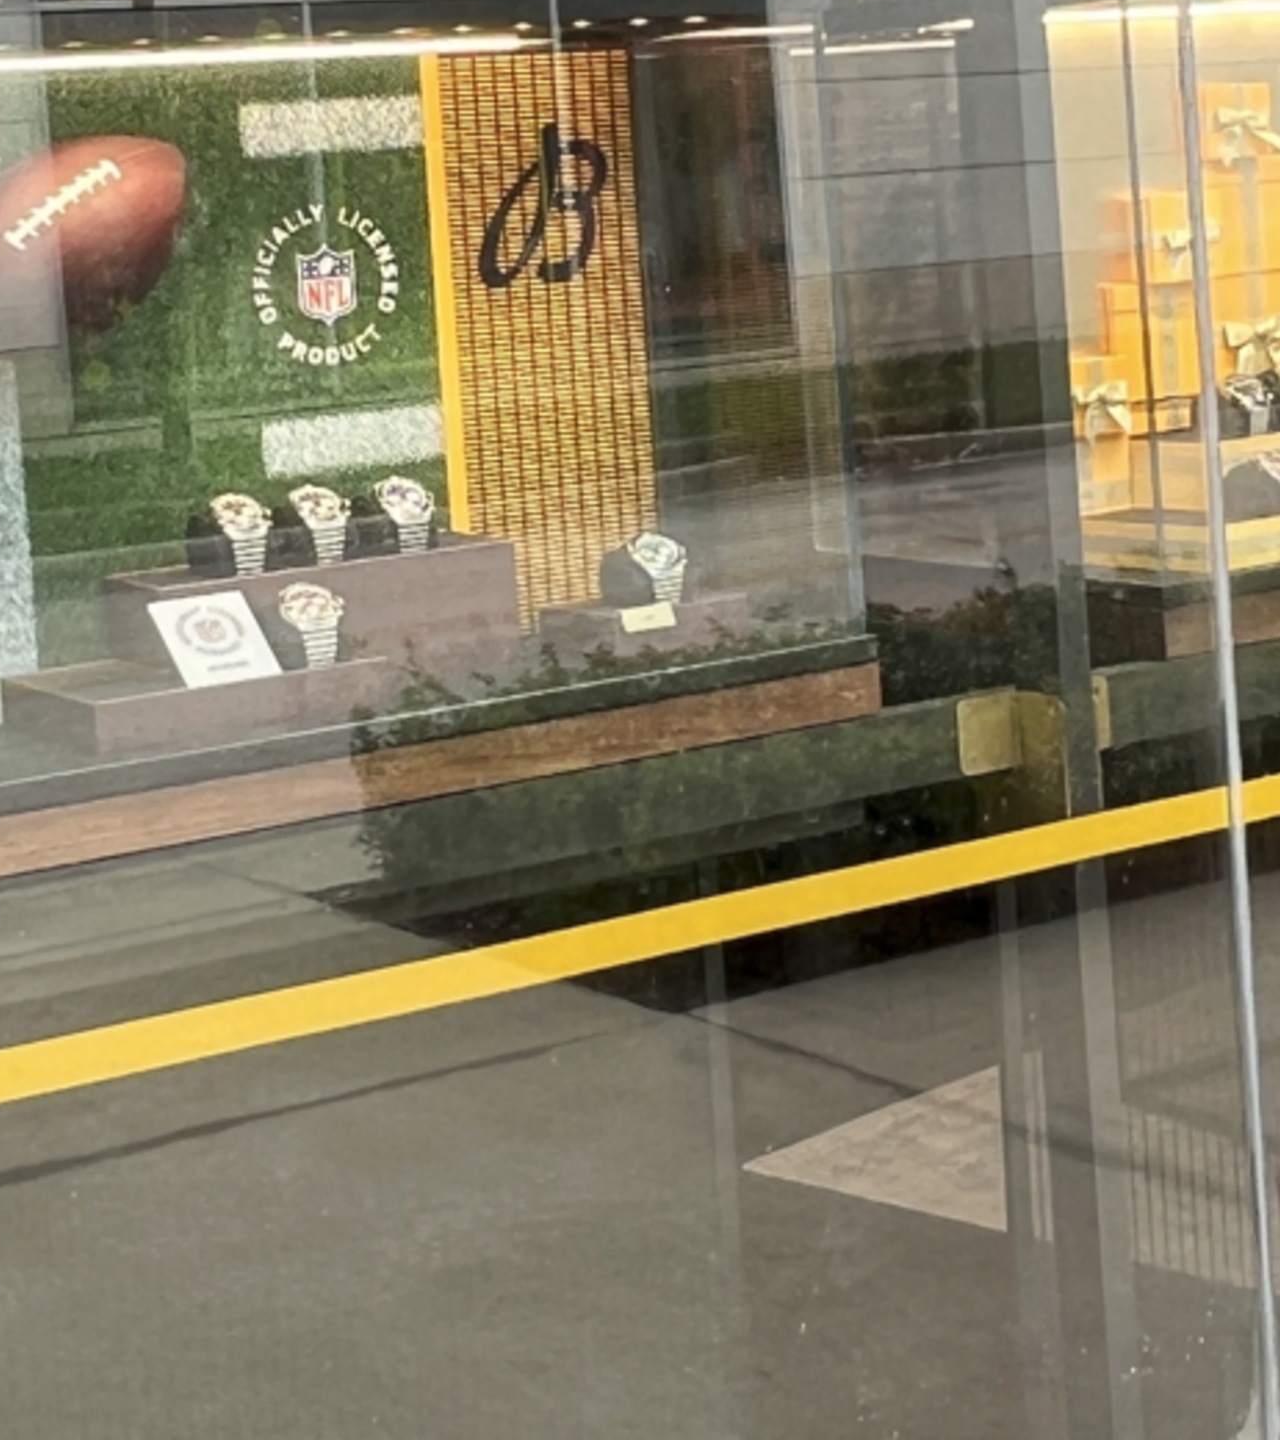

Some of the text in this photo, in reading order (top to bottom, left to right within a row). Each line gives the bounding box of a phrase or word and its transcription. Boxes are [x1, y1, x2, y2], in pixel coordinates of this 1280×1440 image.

[253, 203, 399, 325] OFFICIALLY LICENSED
[307, 279, 349, 309] NFL
[277, 323, 382, 366] PRODUCT
